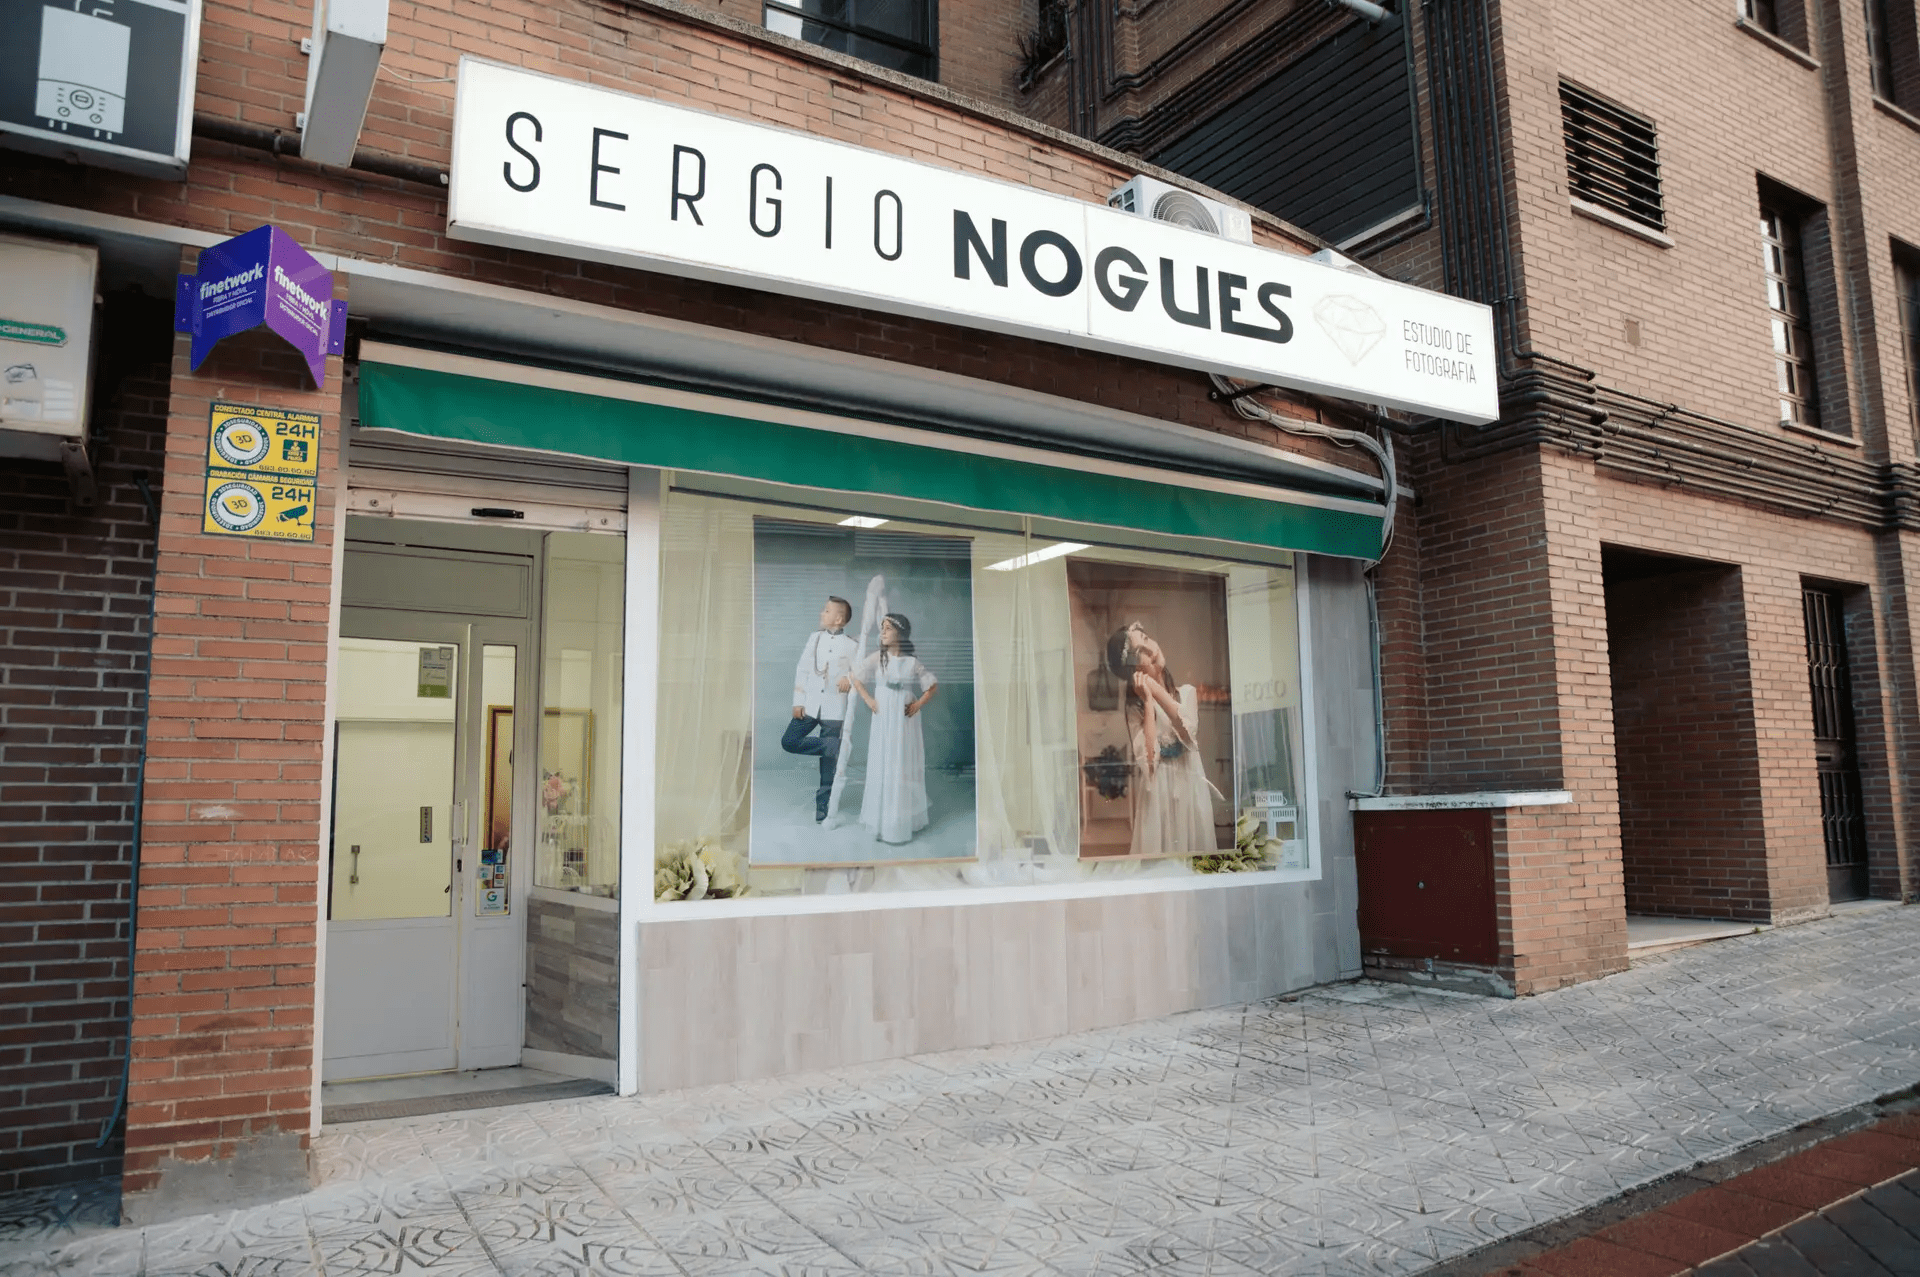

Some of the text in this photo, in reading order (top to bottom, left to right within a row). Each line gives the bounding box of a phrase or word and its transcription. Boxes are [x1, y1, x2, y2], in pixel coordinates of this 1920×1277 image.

[502, 111, 1294, 344] SERGIO NOGUES
[200, 262, 264, 300] finetwork
[274, 265, 328, 321] finetwork
[1403, 319, 1473, 355] ESTUDIO DE
[1405, 350, 1477, 384] FOTOGRAFIA
[256, 409, 286, 419] CENTRAL
[287, 413, 319, 423] ALARMAS
[235, 434, 252, 445] 3D
[276, 422, 315, 439] 24H
[231, 499, 248, 510] 3D
[271, 486, 312, 502] 24H
